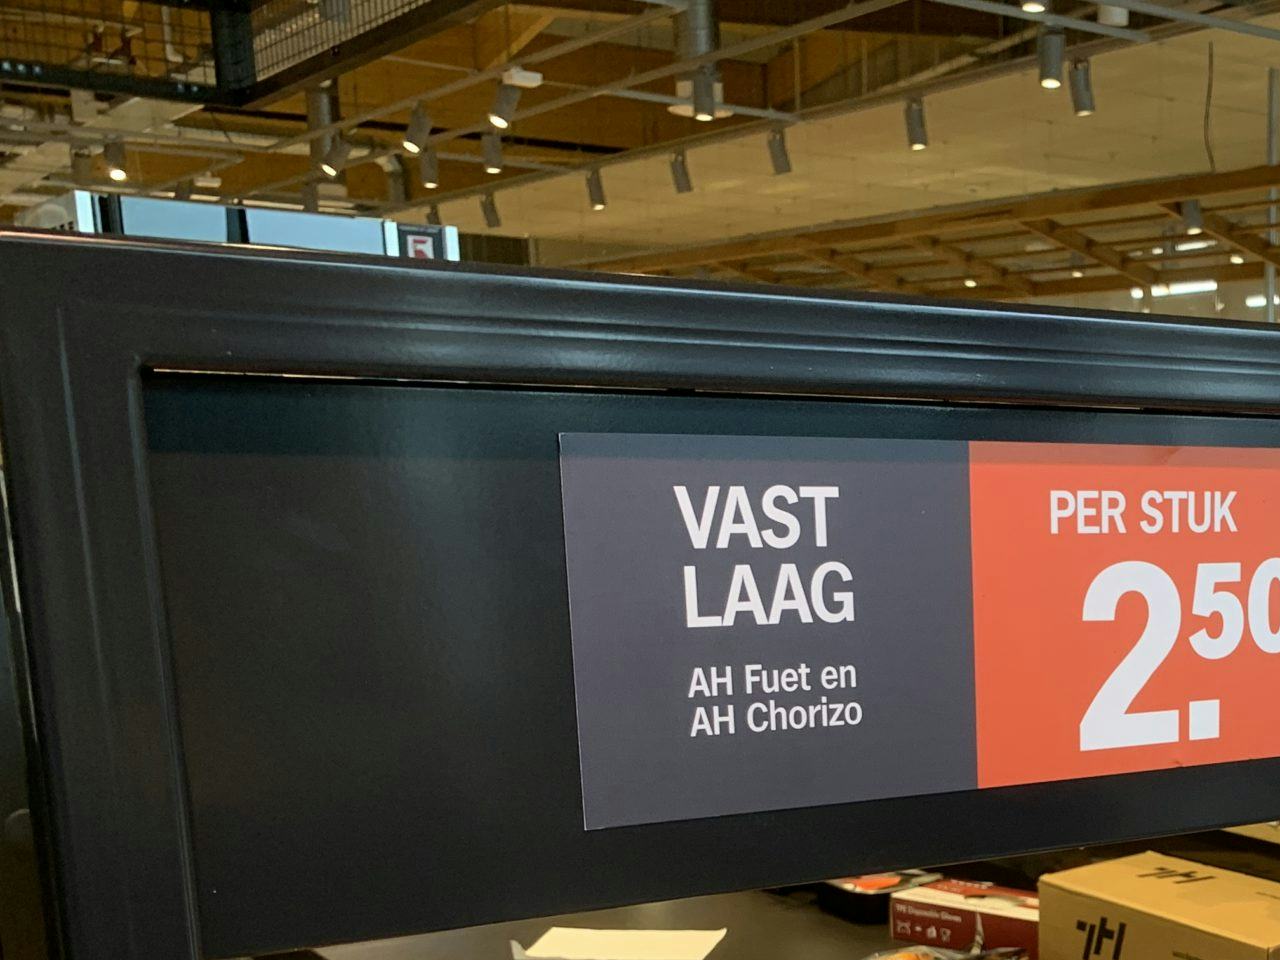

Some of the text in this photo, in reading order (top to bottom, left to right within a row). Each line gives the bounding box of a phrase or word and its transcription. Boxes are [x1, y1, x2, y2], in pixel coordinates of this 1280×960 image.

[674, 485, 840, 548] VAST
[1050, 490, 1238, 534] PER STUK
[683, 561, 855, 628] LAAG
[688, 661, 858, 698] AH Fuet en
[690, 697, 863, 737] AH Chorizo
